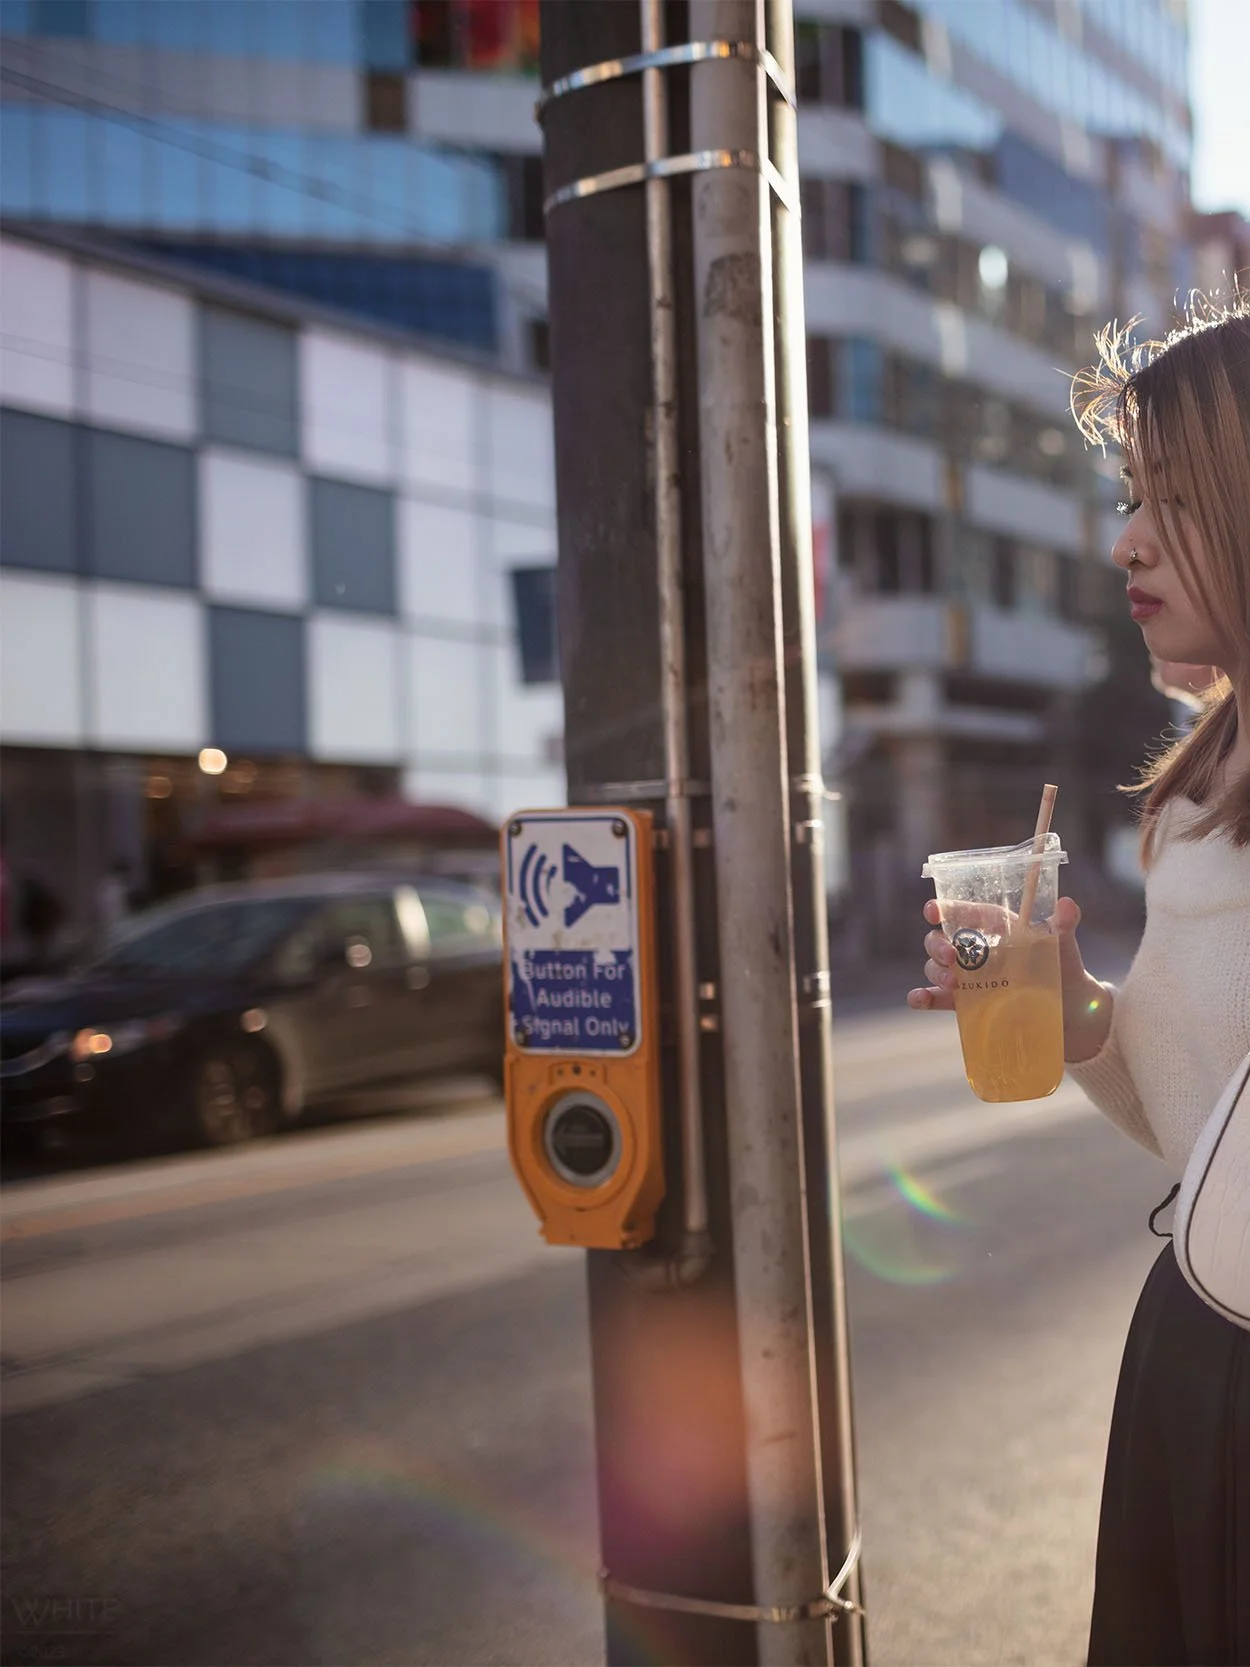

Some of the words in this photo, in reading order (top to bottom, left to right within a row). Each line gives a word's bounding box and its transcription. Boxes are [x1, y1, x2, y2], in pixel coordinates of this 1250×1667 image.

[524, 961, 587, 981] Button
[593, 962, 626, 980] For
[537, 988, 612, 1008] Audible
[522, 1015, 579, 1040] Signal
[585, 1016, 630, 1037] Only
